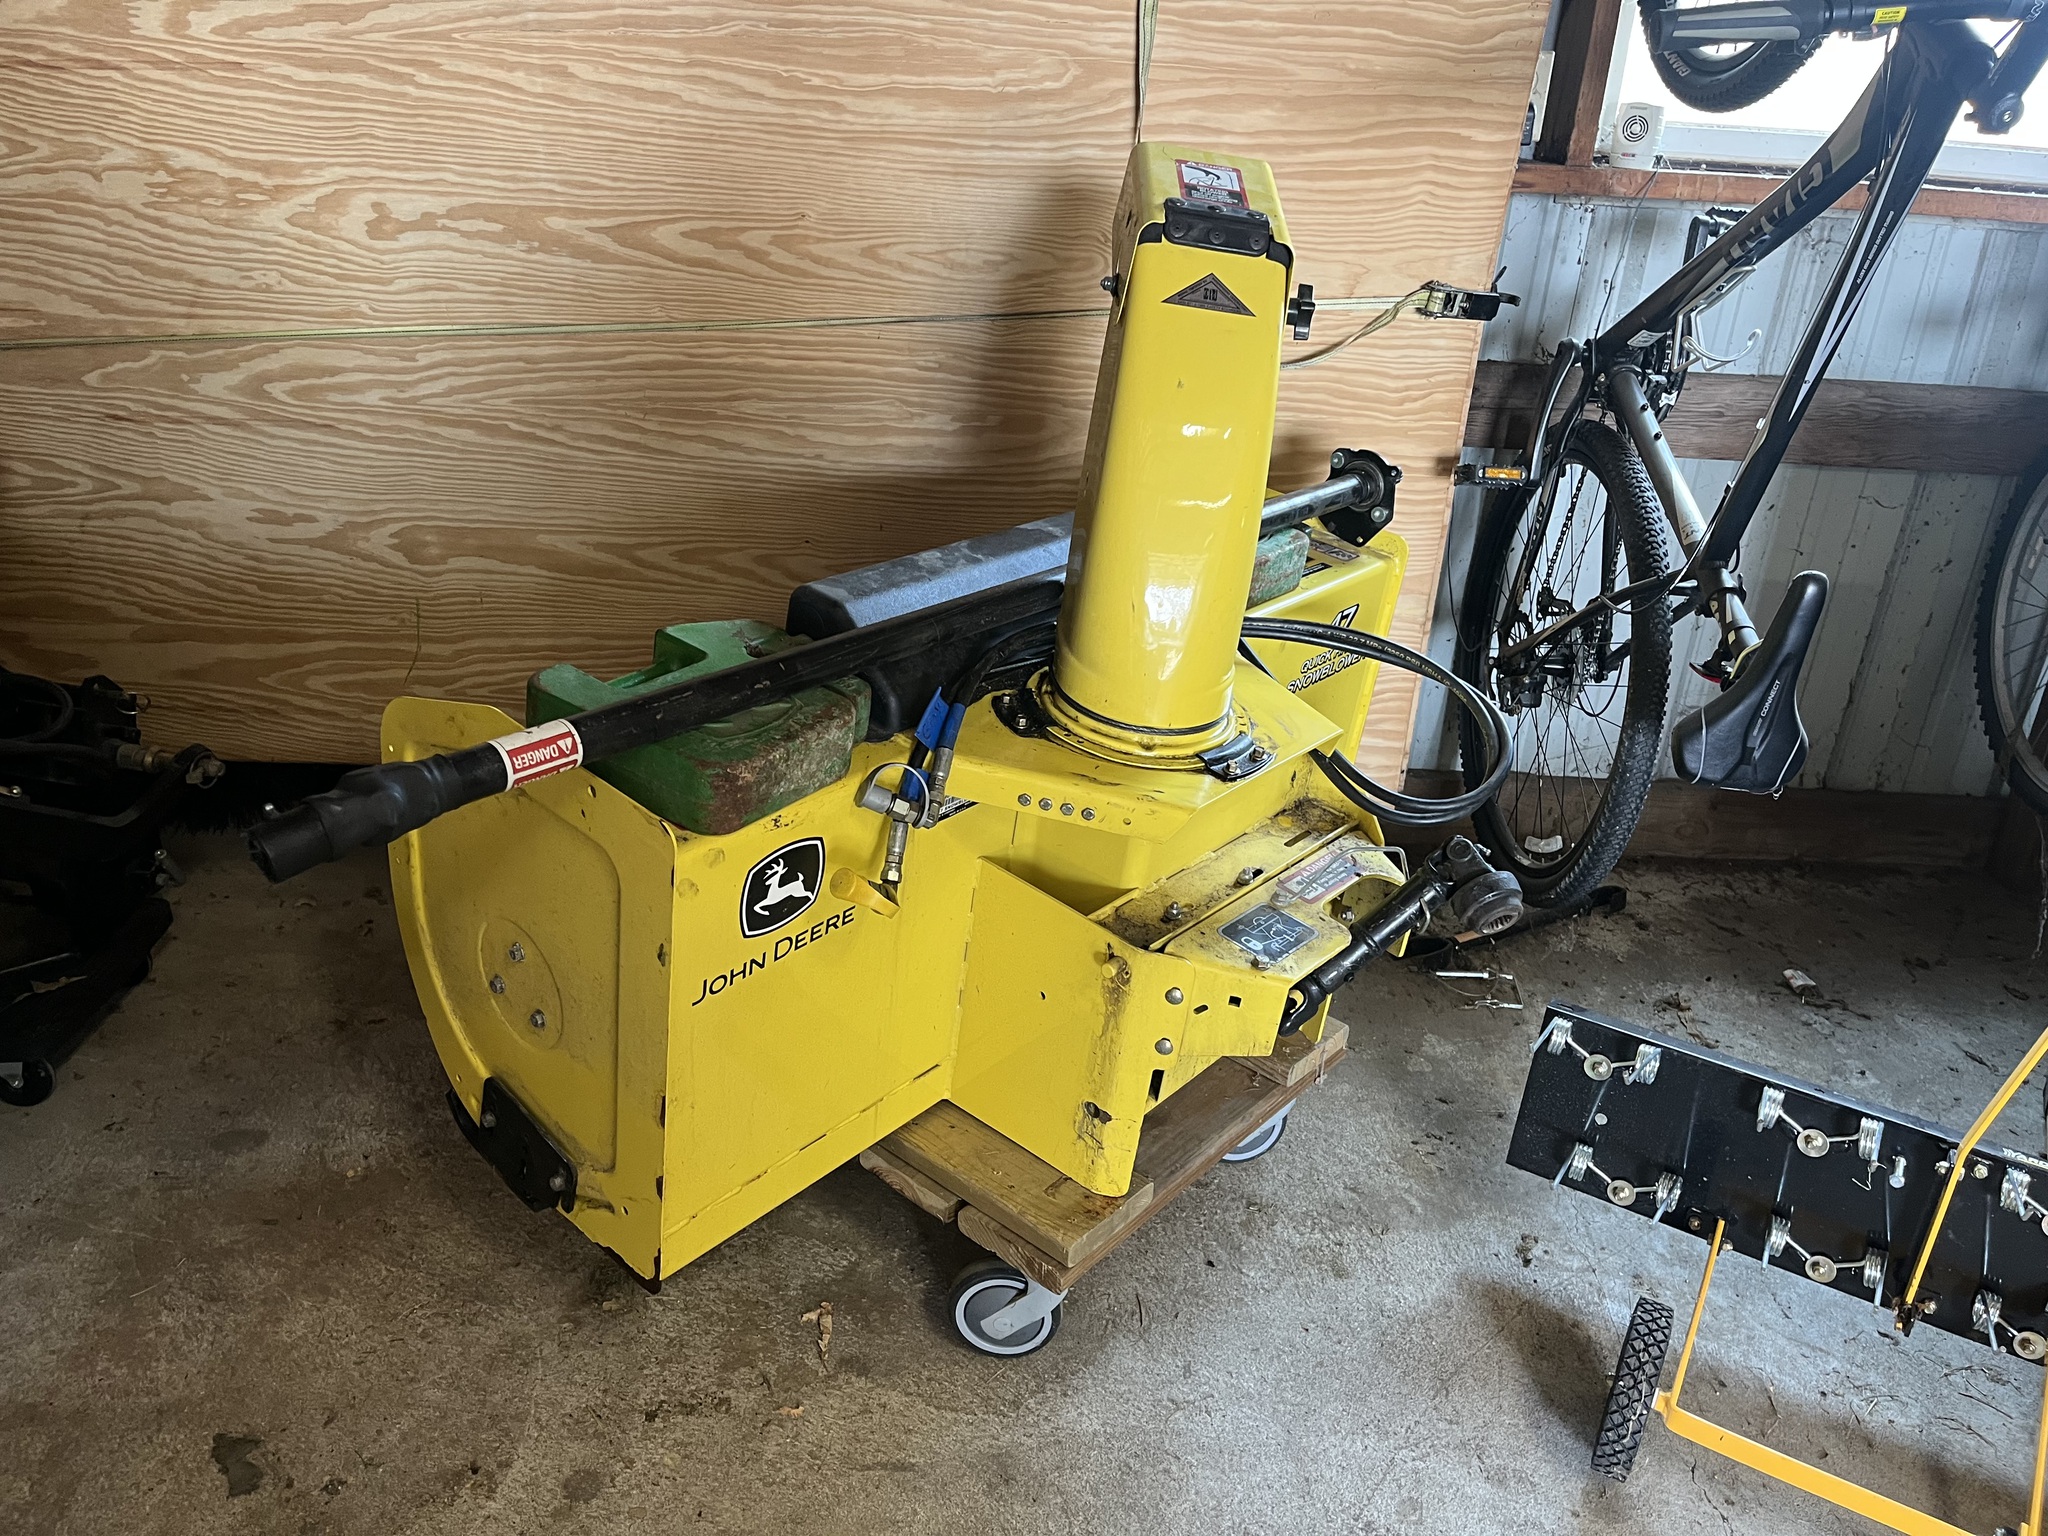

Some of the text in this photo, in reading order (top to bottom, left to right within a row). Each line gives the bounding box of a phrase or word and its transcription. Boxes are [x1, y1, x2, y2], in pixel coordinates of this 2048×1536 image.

[1663, 50, 1692, 77] GIANT
[1301, 649, 1334, 674] QUICK
[1760, 679, 1781, 717] CONNECT
[512, 744, 559, 769] DANGER
[691, 905, 857, 1007] JOHN DEERE
